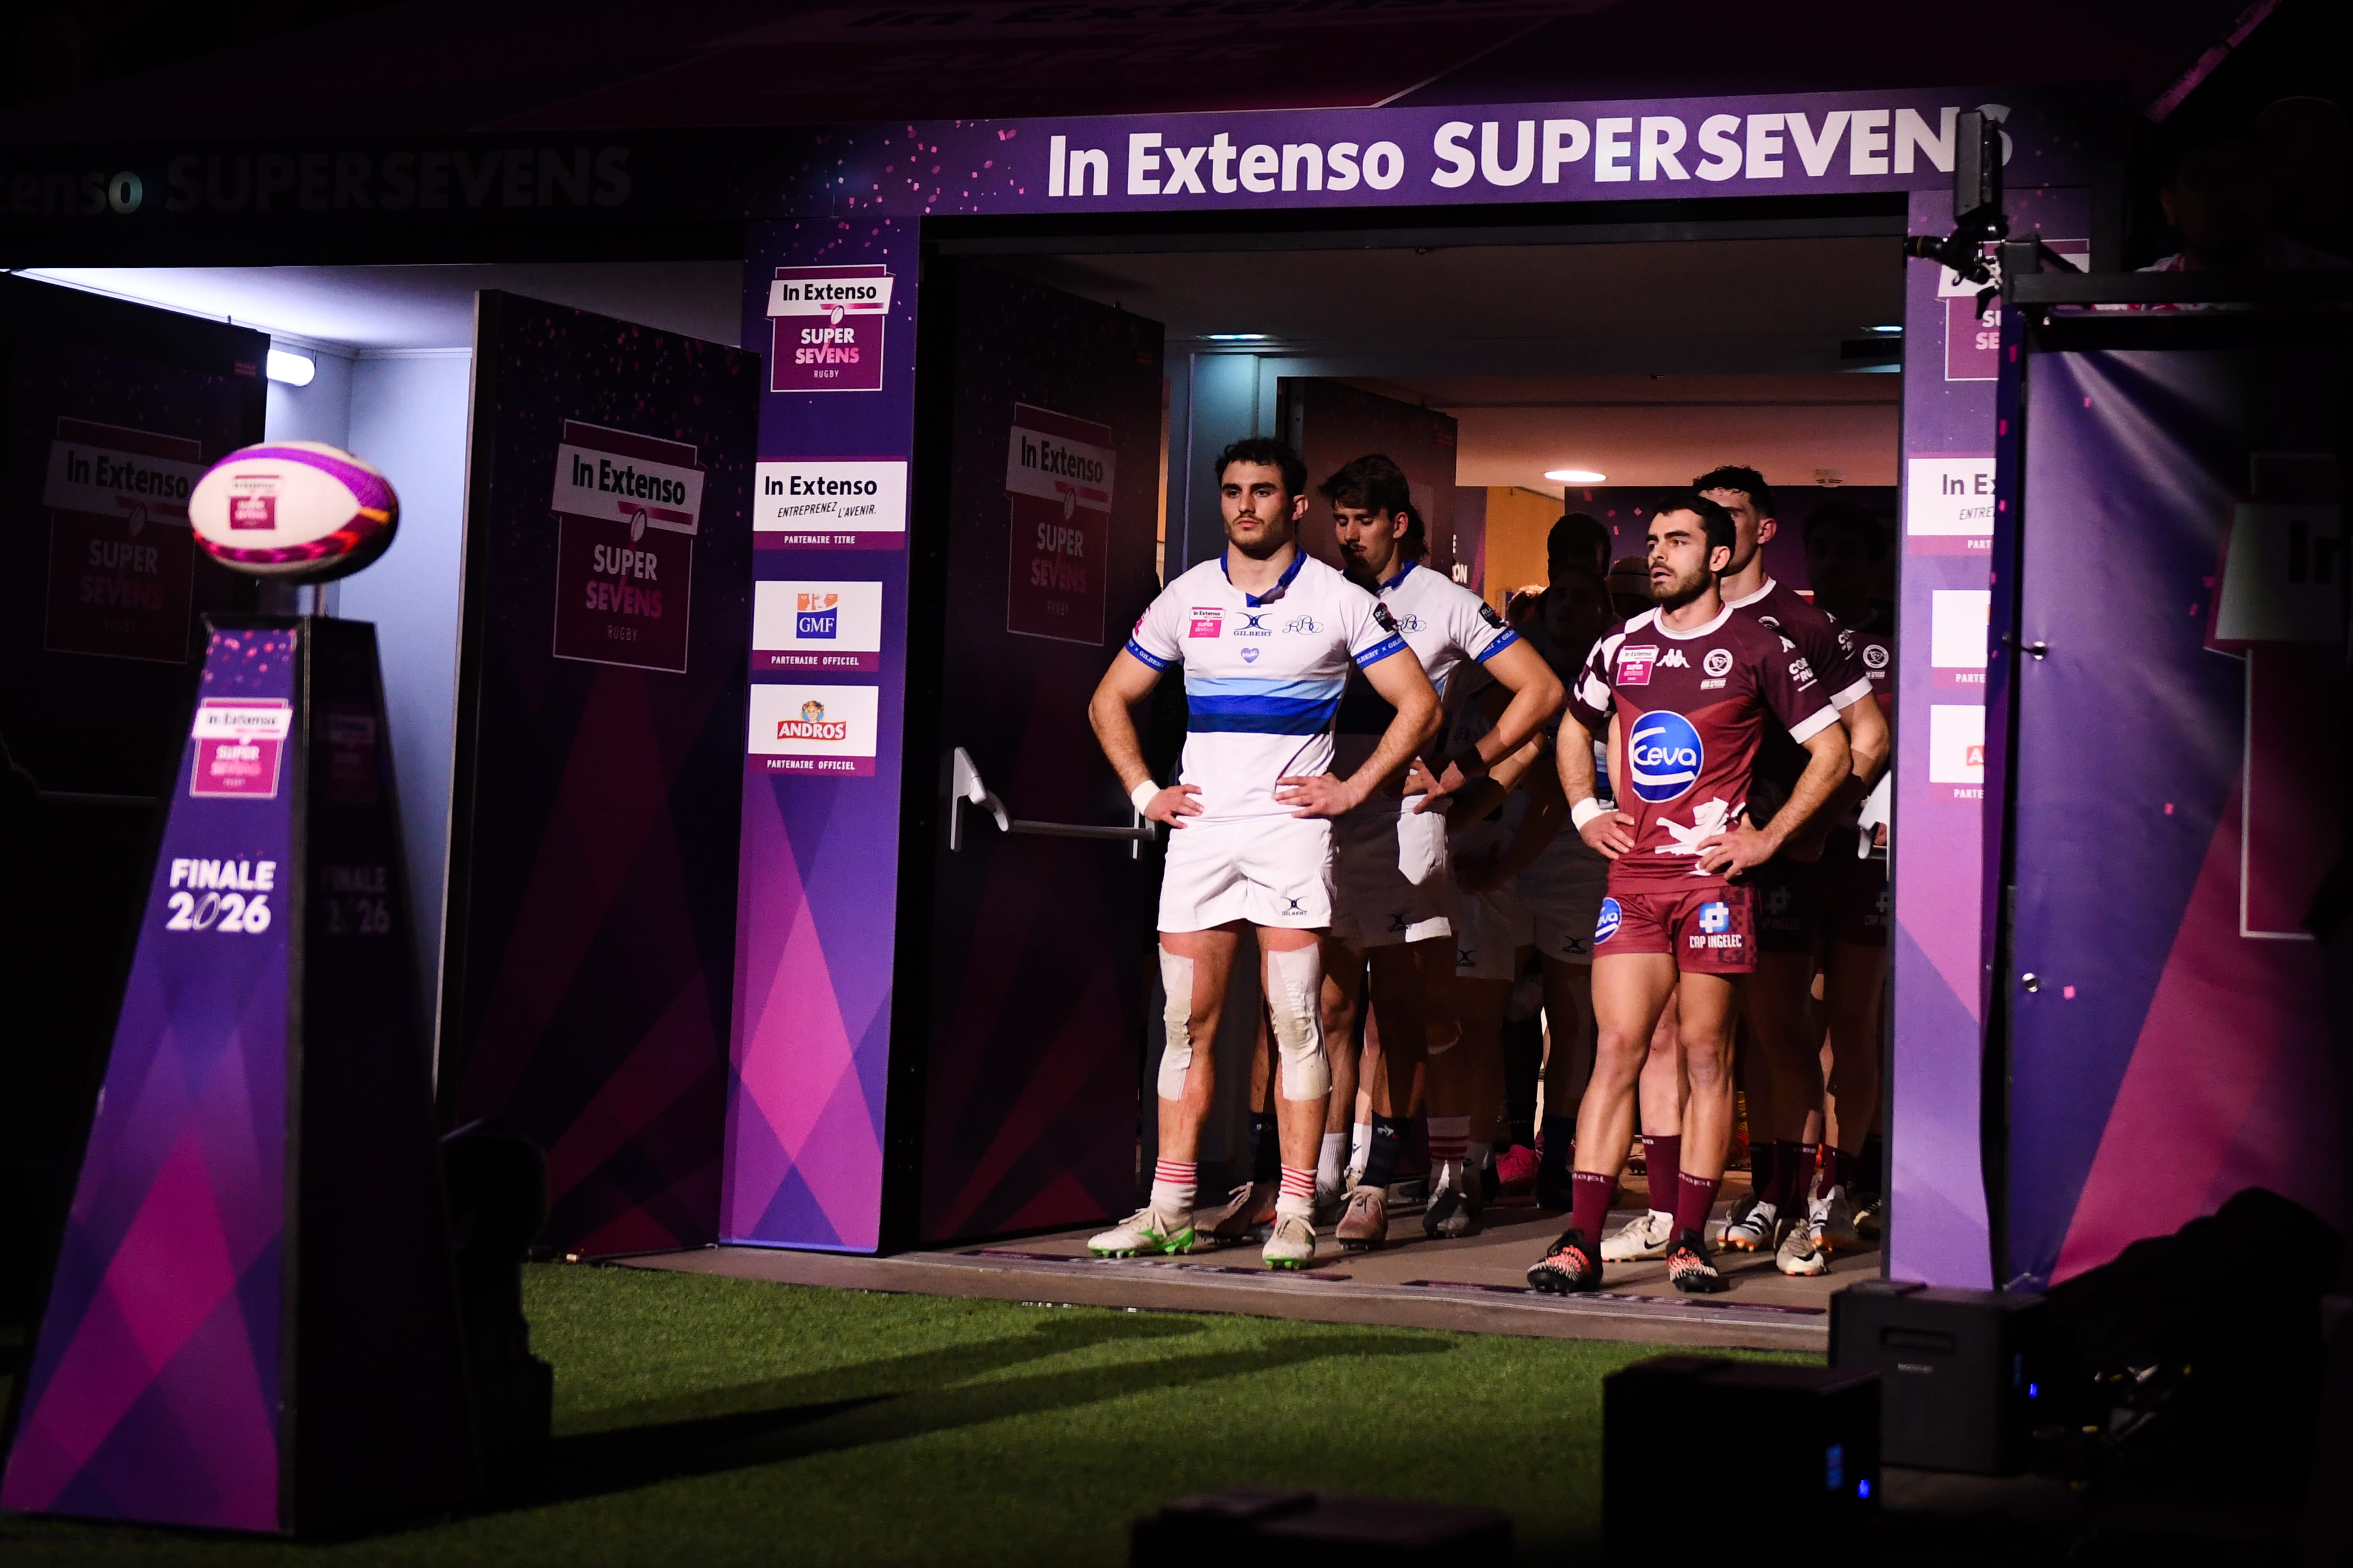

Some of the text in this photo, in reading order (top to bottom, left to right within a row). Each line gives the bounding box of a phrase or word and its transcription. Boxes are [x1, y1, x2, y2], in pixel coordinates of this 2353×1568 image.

[1048, 134, 1109, 197] In
[1127, 132, 1405, 196] Extenso
[0, 146, 632, 216] enso SUPERSEVENS
[783, 284, 877, 301] In Extenso
[800, 328, 855, 344] SUPER
[795, 347, 860, 364] SEVENS
[814, 370, 839, 378] RUGBY
[1022, 436, 1103, 484] In Extenso
[573, 454, 686, 505] In Extenso
[765, 475, 877, 496] In Extenso
[1943, 474, 1964, 494] In
[777, 502, 838, 518] ENTREPRENEZ
[784, 536, 856, 544] PARTENAIRE TITRE
[1037, 522, 1084, 557] SUPER
[593, 544, 658, 581] SUPER
[585, 580, 664, 619] SEVENS
[607, 625, 638, 642] RUGBY
[799, 617, 834, 633] GMF
[771, 656, 859, 665] PARTENAIRE OFFICIEL
[778, 723, 844, 739] ANDROS
[767, 760, 856, 770] PARTENAIRE OFFICIEL
[169, 858, 277, 891] FINALE
[165, 891, 272, 934] 2026
[1689, 934, 1742, 948] CAP INGELEC
